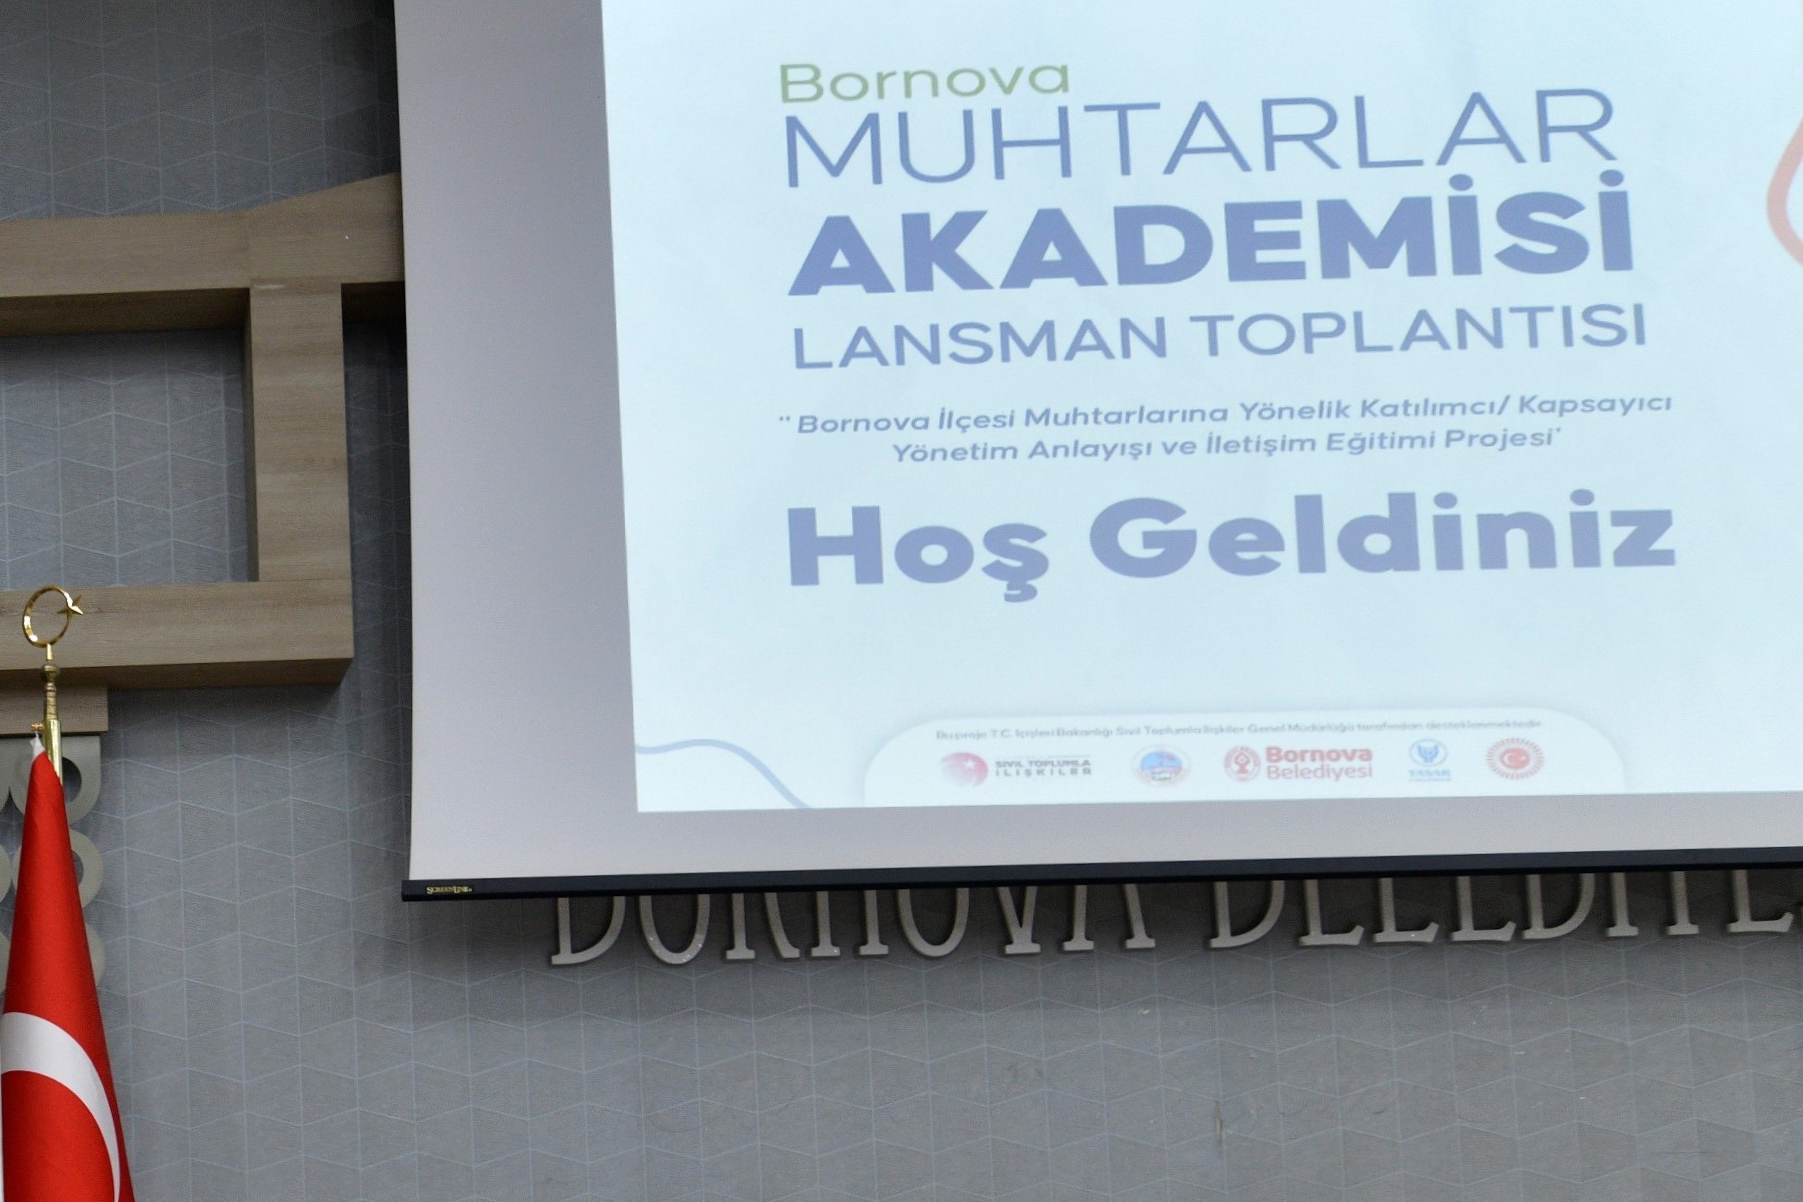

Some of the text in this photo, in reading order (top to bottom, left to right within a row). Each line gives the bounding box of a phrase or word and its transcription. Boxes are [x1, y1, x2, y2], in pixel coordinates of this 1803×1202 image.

[780, 60, 1071, 104] Bornova
[785, 87, 1619, 188] MUHTARLAR
[787, 169, 1635, 297] AKADEMİSİ
[793, 302, 1648, 370] LANSMAN TOPLANTISI
[938, 406, 1016, 433] İlçesi
[1025, 405, 1229, 428] Muhtarlarına
[1240, 400, 1350, 422] Yönelik
[1518, 394, 1673, 417] Kapsayıcı
[892, 440, 1019, 463] Yönetim
[1027, 437, 1153, 461] Anlayışı
[1161, 440, 1197, 456] ve
[1206, 430, 1317, 457] İletişim
[1326, 429, 1436, 456] Eğitimi
[787, 488, 1678, 604] Hoş Geldiniz
[1265, 745, 1373, 764] Bornova
[1266, 763, 1373, 782] Belediyesi
